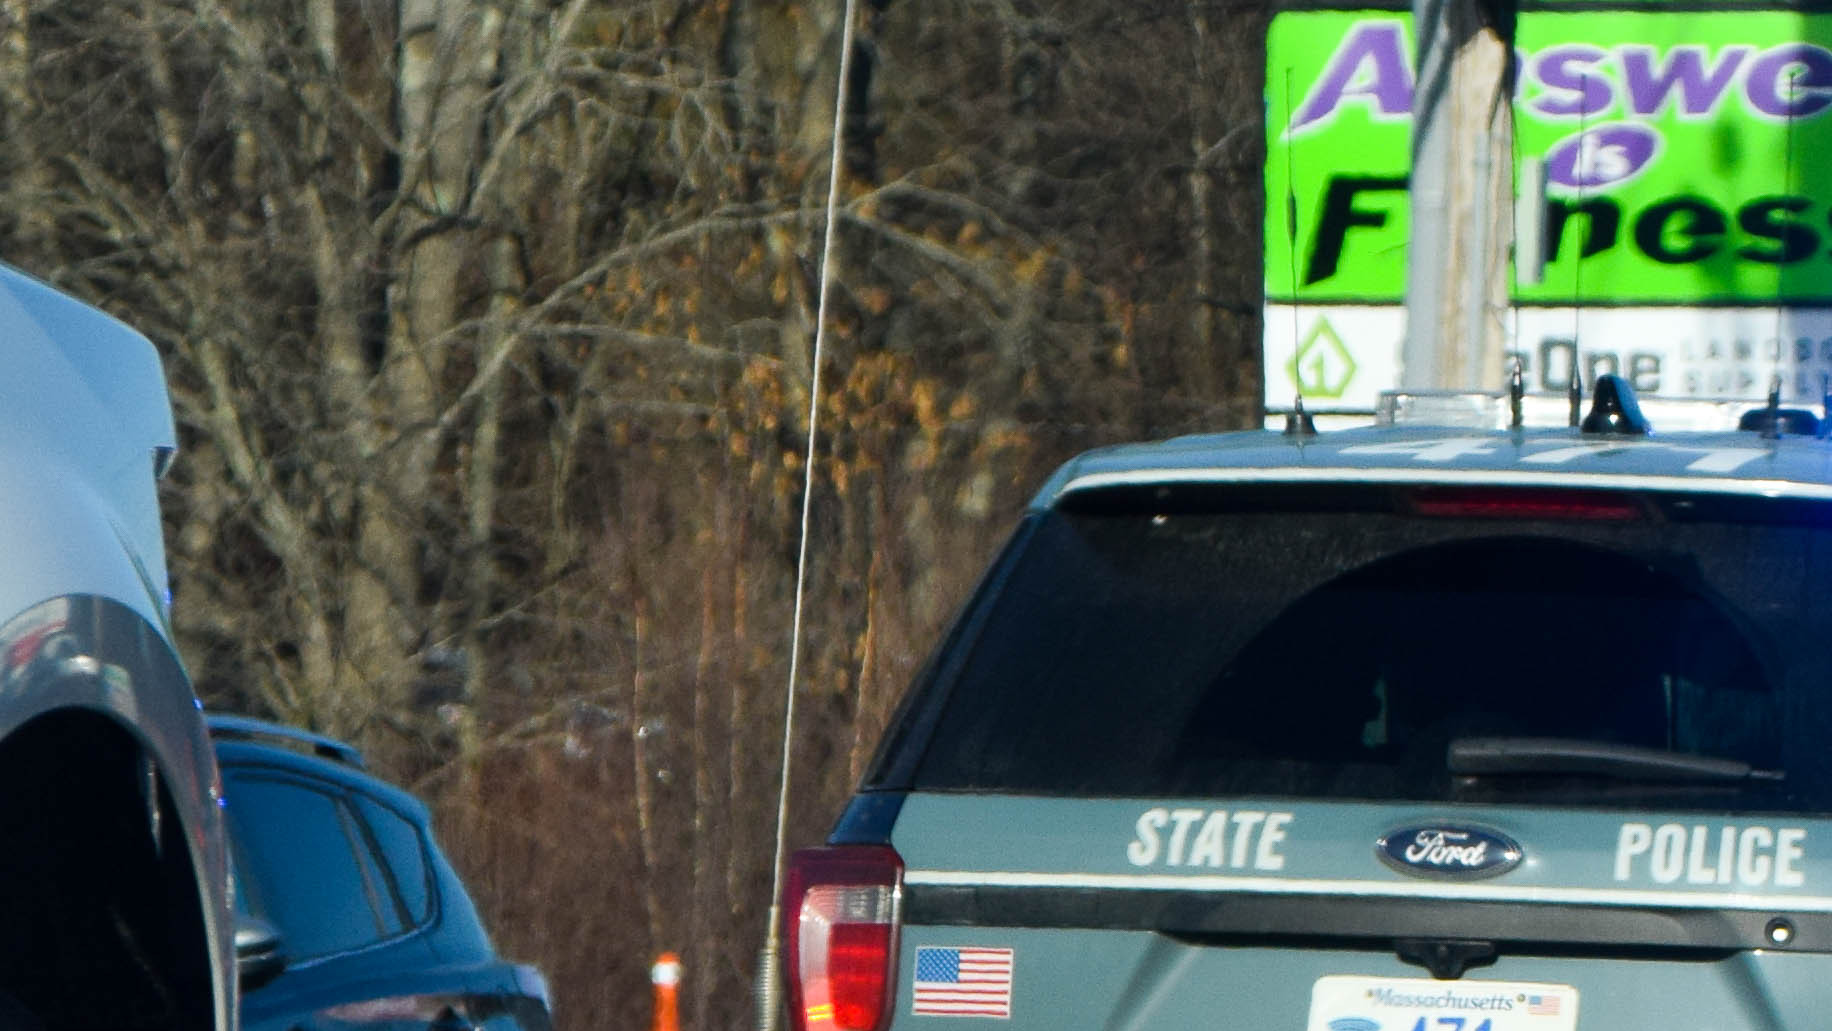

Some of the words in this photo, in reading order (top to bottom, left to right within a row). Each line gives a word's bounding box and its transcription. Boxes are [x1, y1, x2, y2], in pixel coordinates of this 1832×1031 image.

[1572, 138, 1632, 181] is
[1128, 808, 1294, 872] STATE
[1405, 827, 1488, 868] Ford
[1614, 822, 1807, 888] POLICE
[1372, 988, 1513, 1011] Massachusetts
